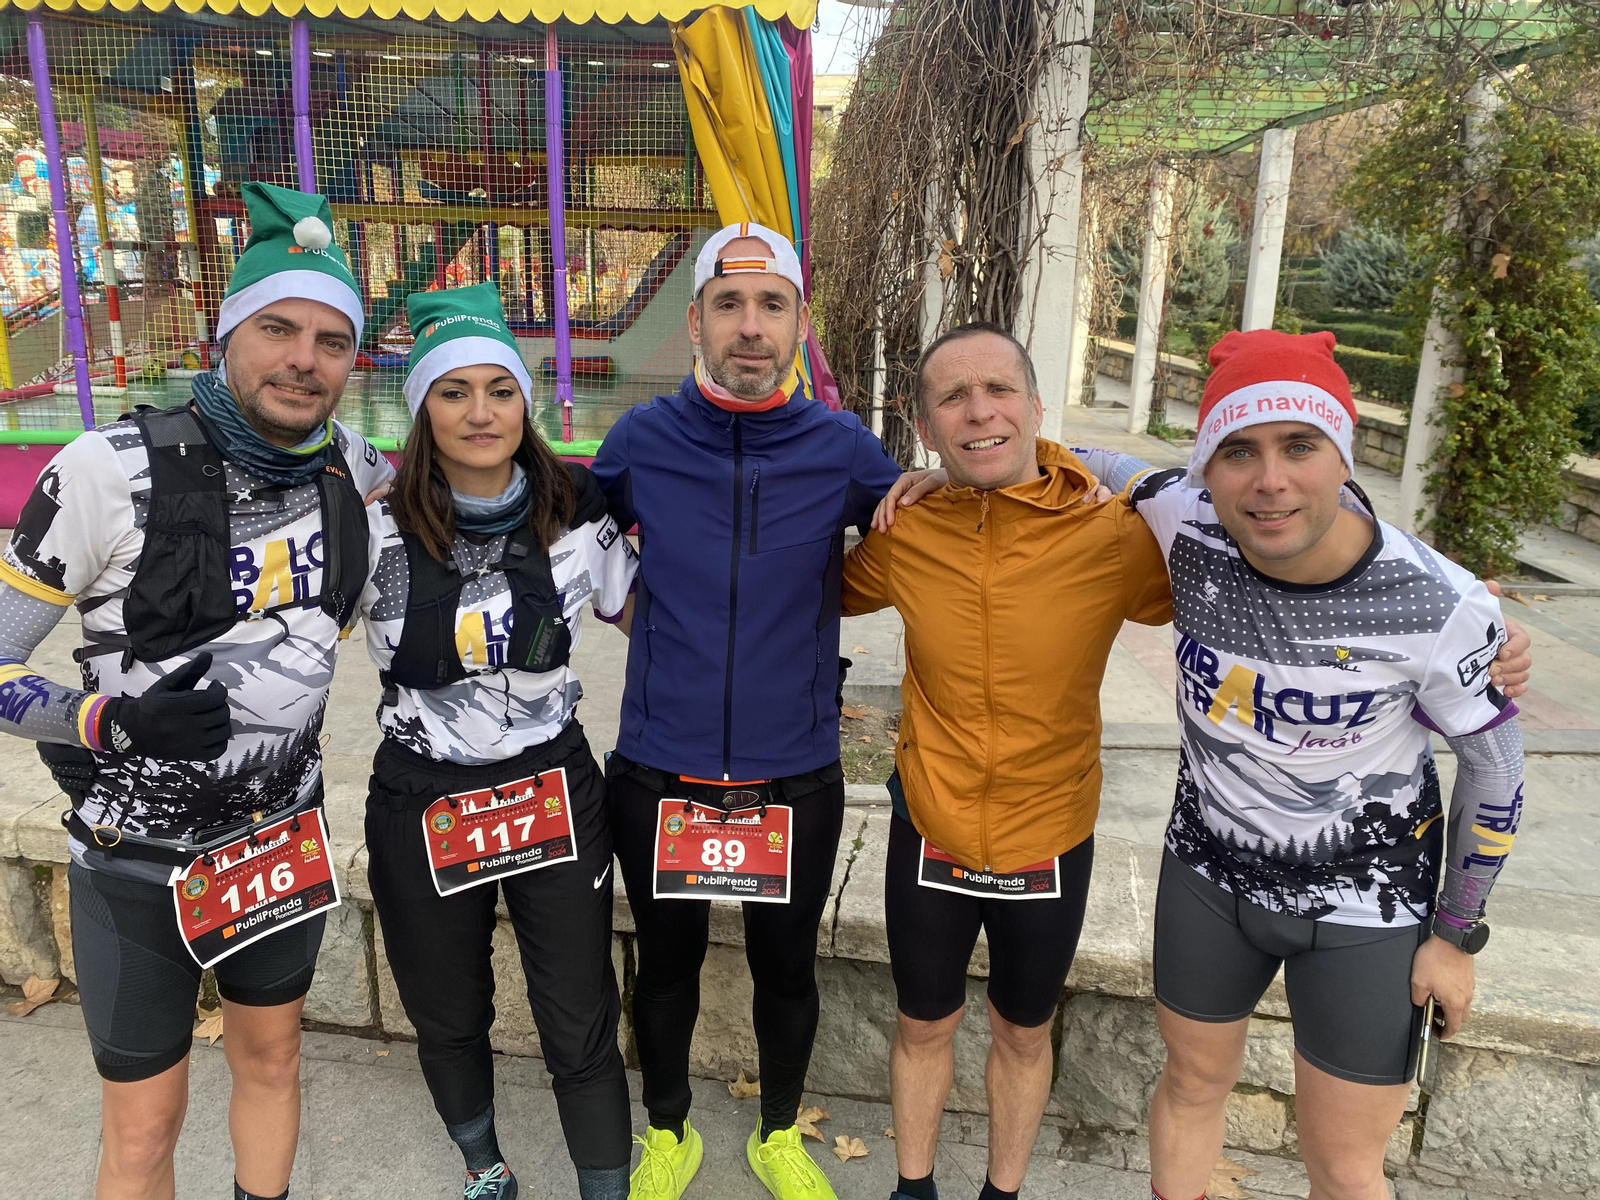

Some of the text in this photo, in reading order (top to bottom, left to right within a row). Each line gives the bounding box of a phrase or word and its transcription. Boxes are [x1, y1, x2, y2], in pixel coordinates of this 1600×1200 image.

[434, 315, 500, 330] PubliPrenda
[1257, 395, 1344, 433] navidad
[1318, 659, 1362, 673] SPALL
[466, 814, 536, 853] 117
[480, 847, 542, 870] PubliPrenda
[548, 848, 567, 859] 2024
[701, 838, 746, 867] 89
[215, 868, 242, 883] Subida
[259, 844, 294, 863] Castillo
[229, 868, 254, 880] Santa
[256, 849, 295, 868] Catalina
[517, 855, 543, 866] Promowear
[697, 875, 758, 887] PubliPrenda
[963, 871, 1026, 886] PubliPrenda
[220, 862, 295, 914] 116
[732, 885, 757, 893] Promowear
[1029, 883, 1050, 892] 2024
[308, 894, 329, 910] 2024
[235, 898, 302, 933] PubliPrenda
[275, 906, 303, 921] Promowear
